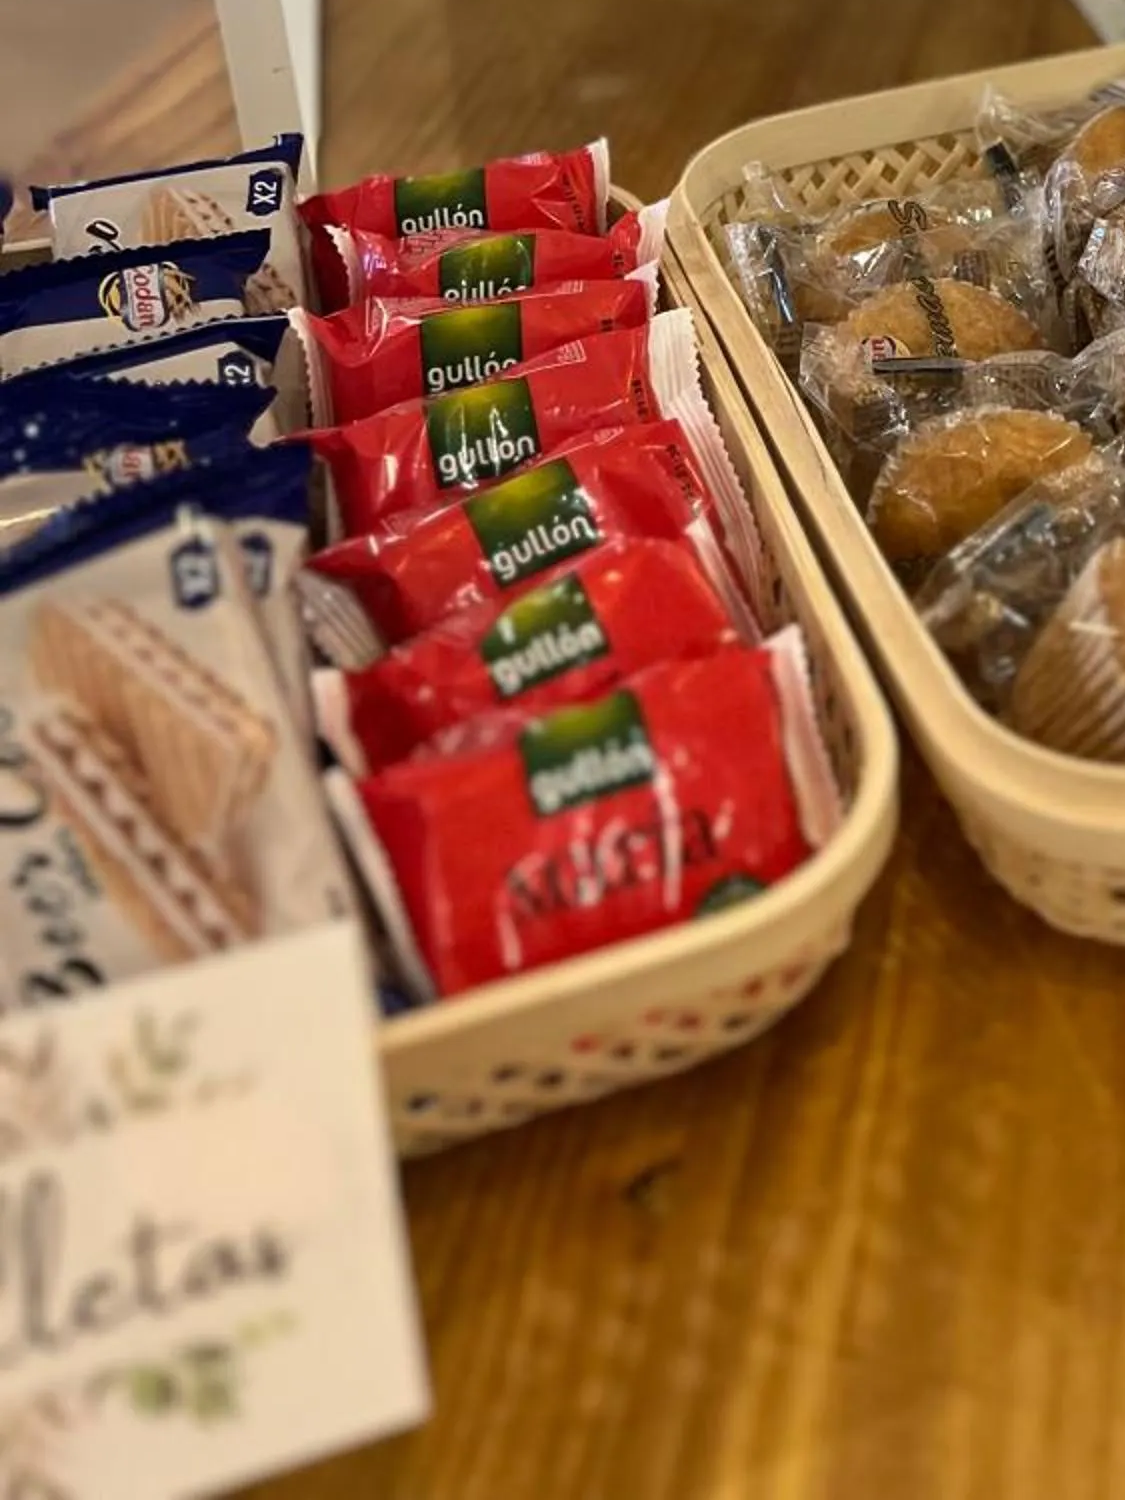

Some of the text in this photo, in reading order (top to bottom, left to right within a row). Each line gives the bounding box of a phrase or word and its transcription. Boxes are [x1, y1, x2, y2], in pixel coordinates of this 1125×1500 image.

[252, 180, 278, 206] X2
[438, 434, 536, 482] gullón
[493, 510, 595, 580] gullón
[493, 620, 603, 695] gullón
[533, 737, 655, 812] gullón
[0, 1164, 290, 1350] letas
